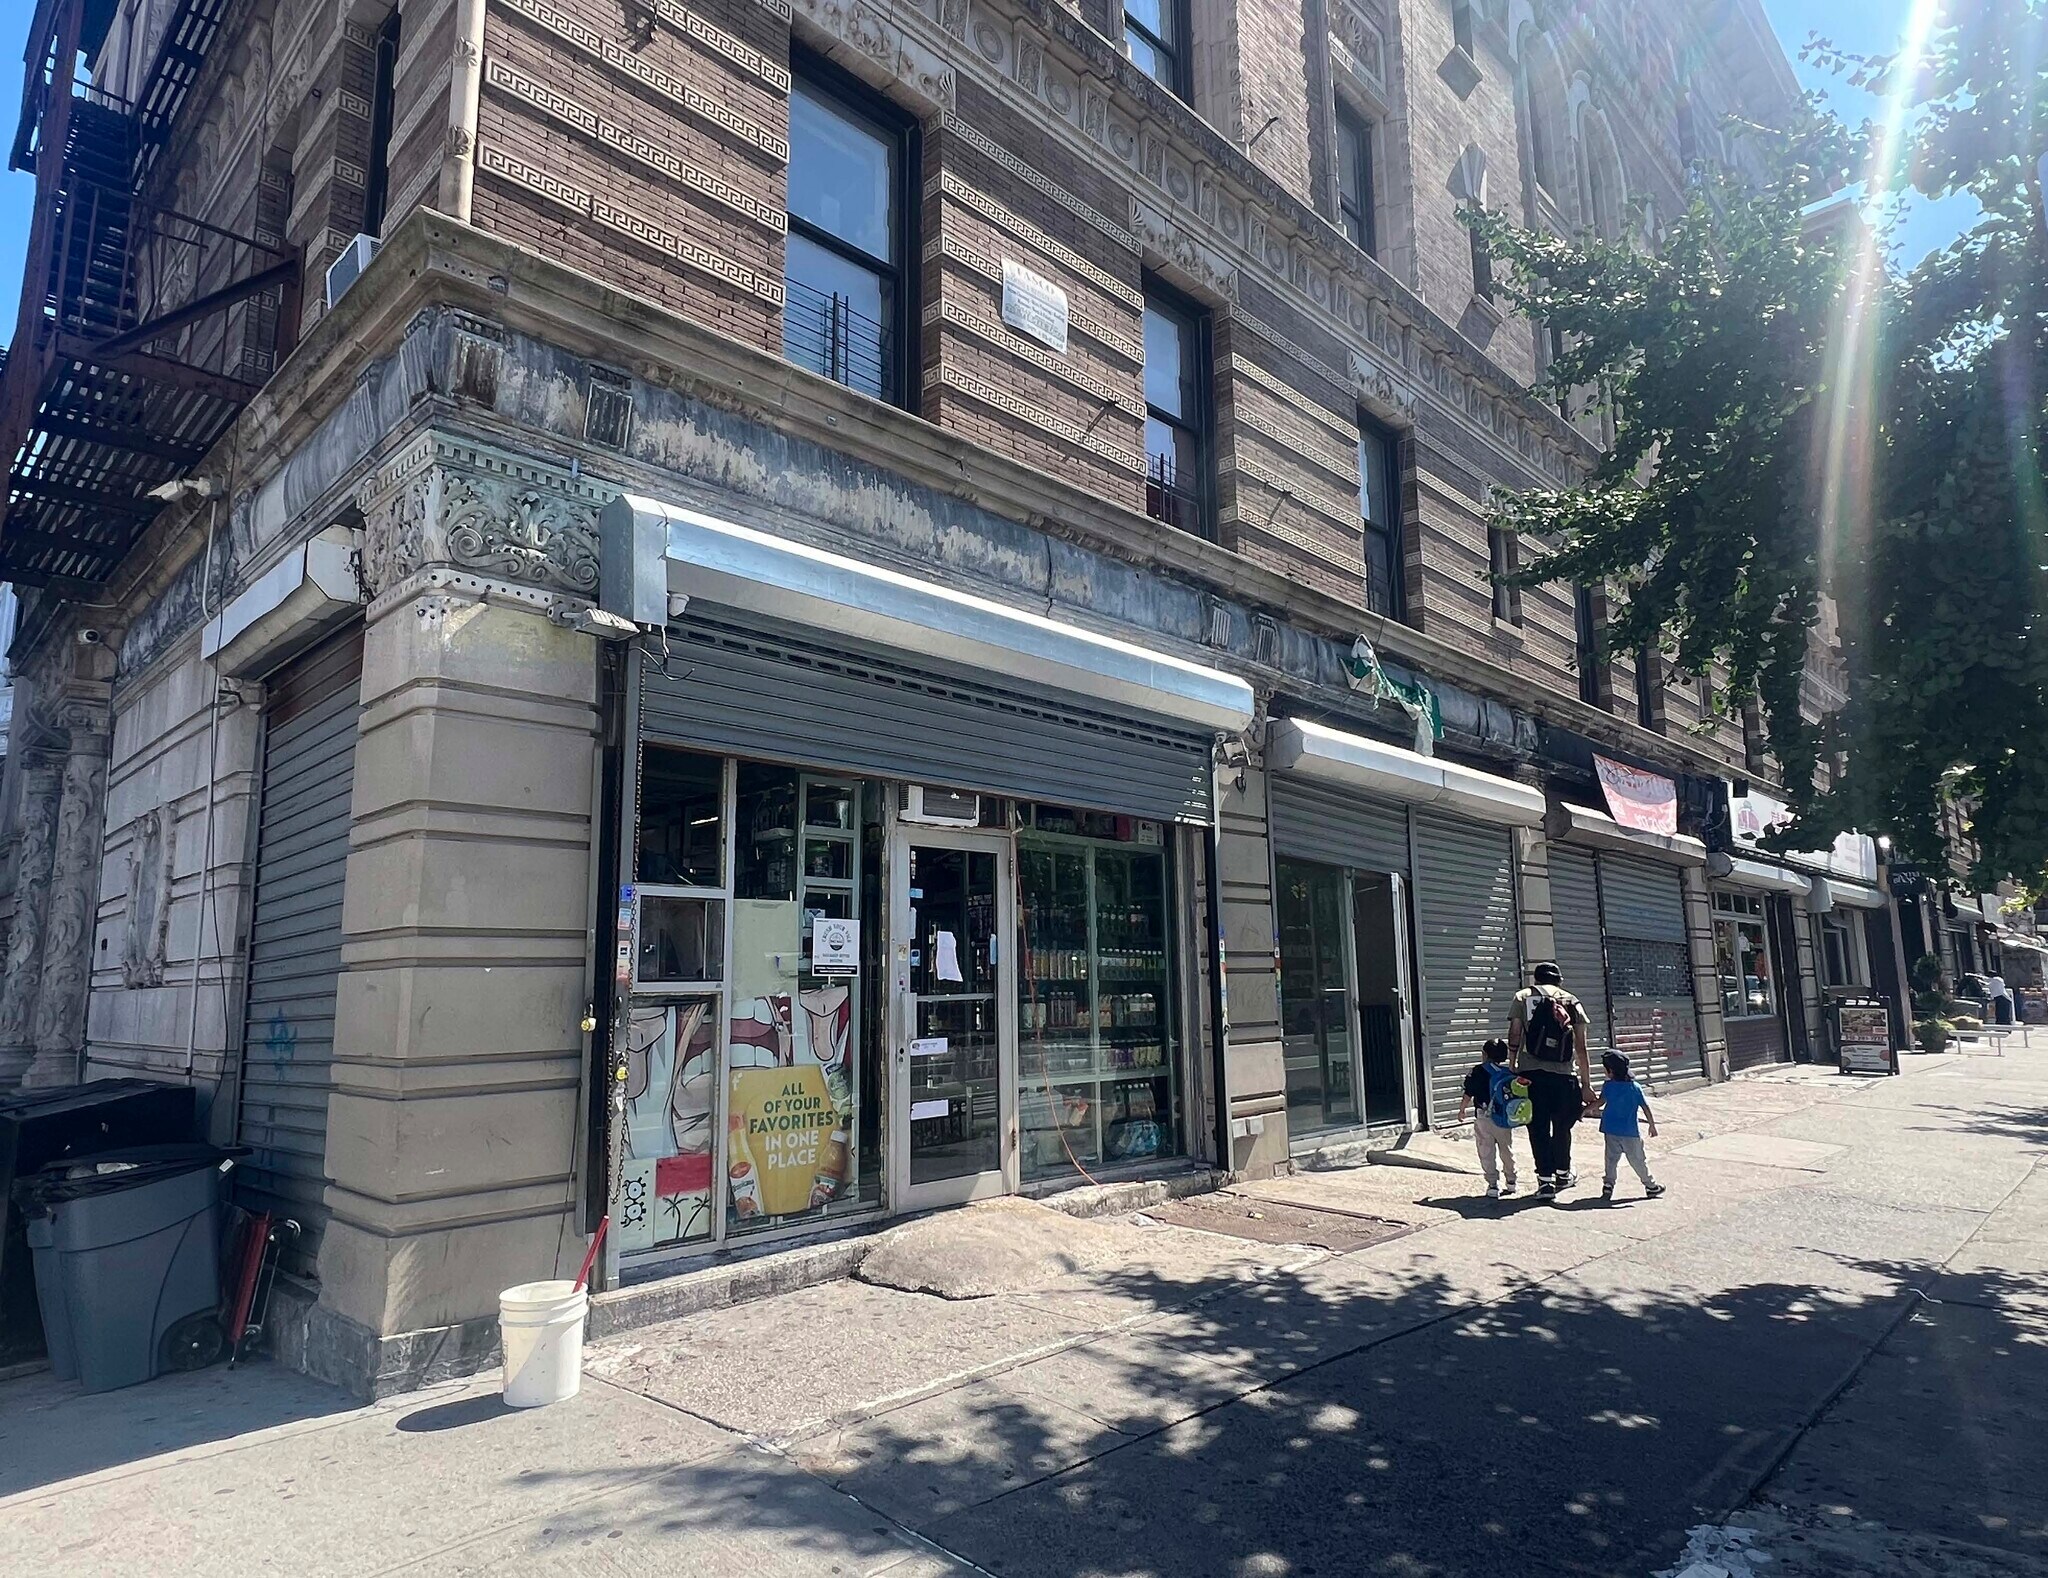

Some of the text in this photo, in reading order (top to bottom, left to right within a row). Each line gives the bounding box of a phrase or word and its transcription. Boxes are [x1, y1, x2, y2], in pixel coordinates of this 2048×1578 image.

[781, 1082, 805, 1097] ALL
[763, 1097, 821, 1114] OF YOUR
[749, 1110, 834, 1134] FAVORITES
[765, 1129, 819, 1151] IN ONE
[768, 1149, 816, 1170] PLACE
